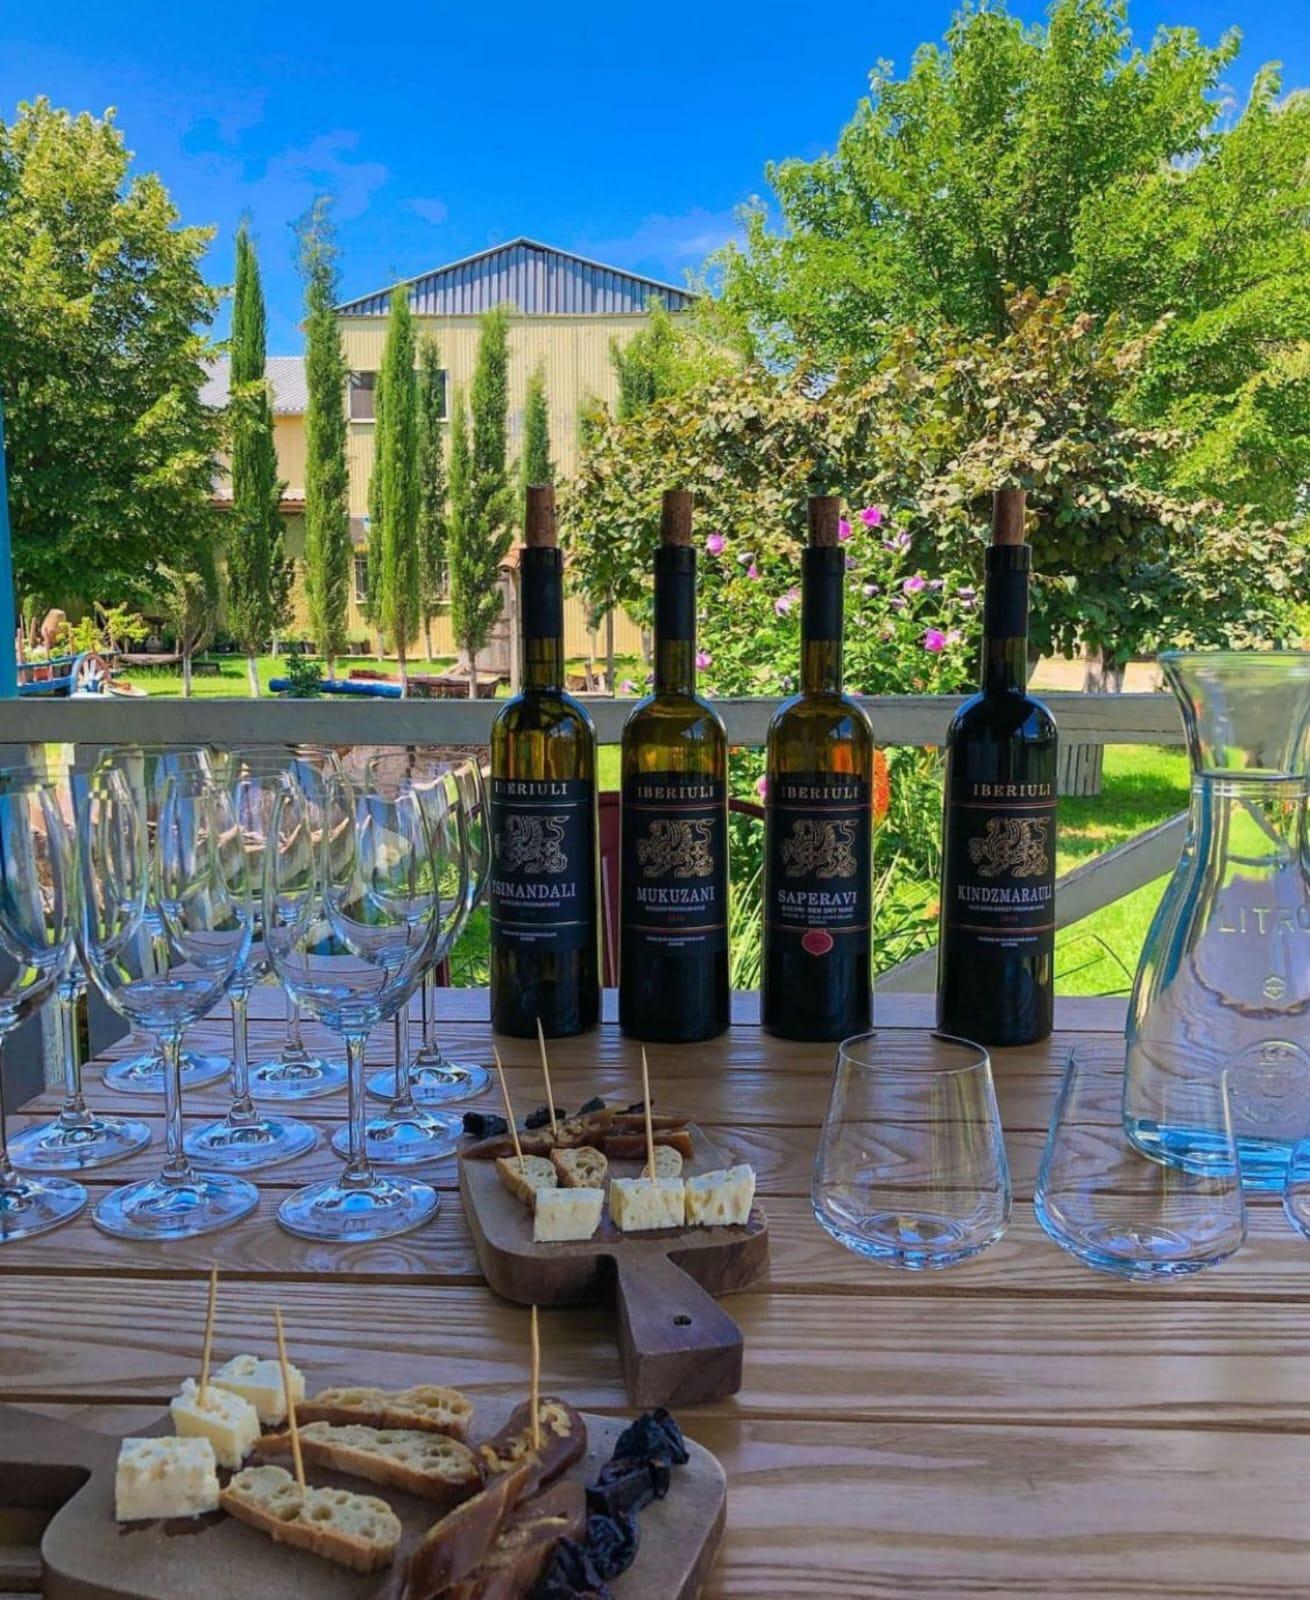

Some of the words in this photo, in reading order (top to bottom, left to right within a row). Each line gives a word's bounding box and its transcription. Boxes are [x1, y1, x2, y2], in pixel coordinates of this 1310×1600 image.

[637, 785, 714, 800] IBERIULI
[781, 786, 858, 800] IBERIULI
[973, 783, 1051, 798] IBERIULI
[636, 886, 715, 903] MUKUZANI
[777, 889, 857, 905] SAPERAVI
[957, 885, 1052, 903] KINDZMARAULI
